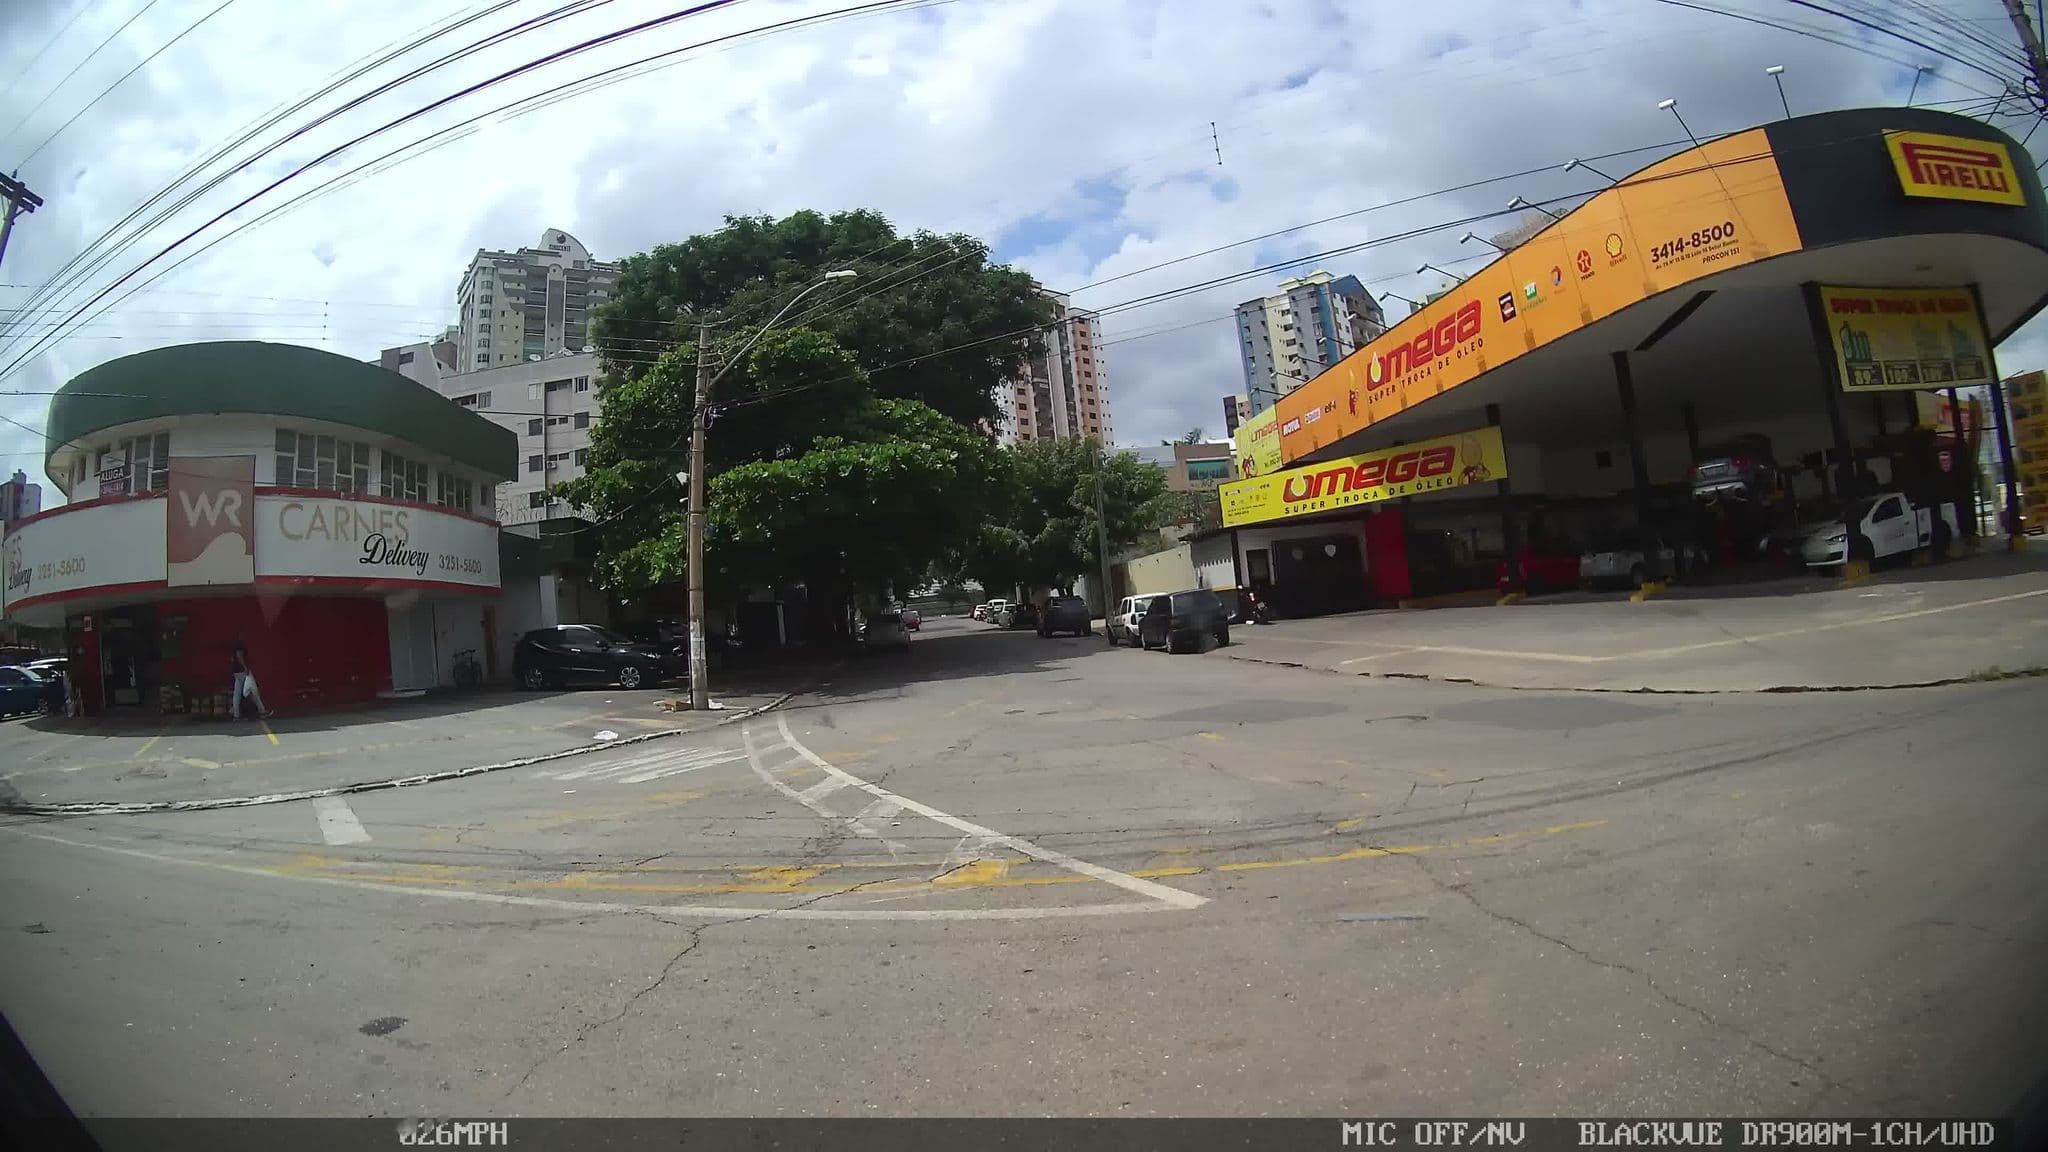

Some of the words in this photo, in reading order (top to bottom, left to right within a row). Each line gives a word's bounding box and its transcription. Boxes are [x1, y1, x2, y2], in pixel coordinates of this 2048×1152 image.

[1901, 142, 2010, 193] PIRELLI
[1651, 221, 1735, 263] 3414-8500
[1702, 249, 1730, 264] PROCON
[1368, 384, 1396, 405] SUPER
[1401, 367, 1432, 389] TROCA
[1438, 357, 1450, 370] DE
[178, 490, 242, 529] WR
[1285, 500, 1326, 515] SUPER
[1335, 490, 1379, 504] TROCA
[1389, 483, 1406, 496] DE
[279, 503, 409, 544] CARNES
[359, 533, 430, 576] Delivery
